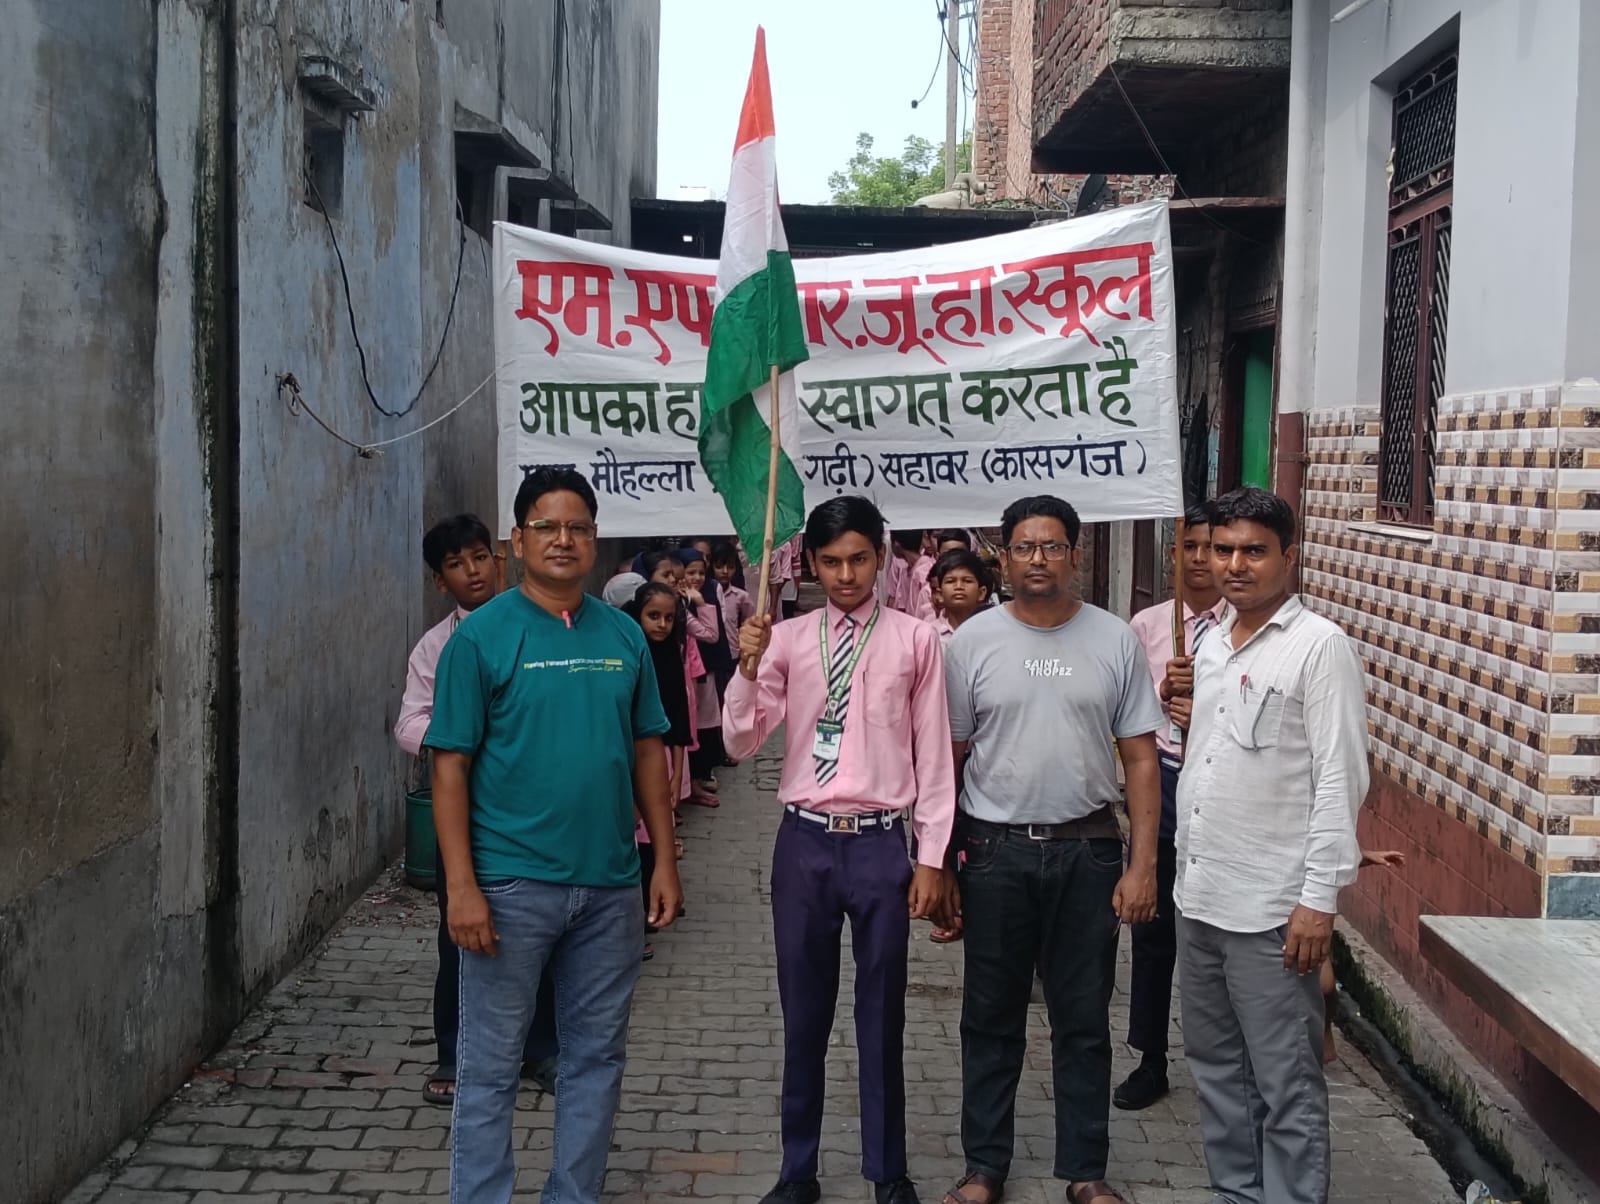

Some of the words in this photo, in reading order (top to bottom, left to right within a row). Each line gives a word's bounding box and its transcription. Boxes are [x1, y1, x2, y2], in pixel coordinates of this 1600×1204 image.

[519, 381, 661, 437] आपका
[959, 362, 1092, 425] करता
[1095, 335, 1140, 428] है
[589, 446, 697, 501] मौहल्ला
[878, 450, 970, 490] सहावर
[1024, 658, 1060, 668] SAINT
[1029, 666, 1073, 677] TROPEZ
